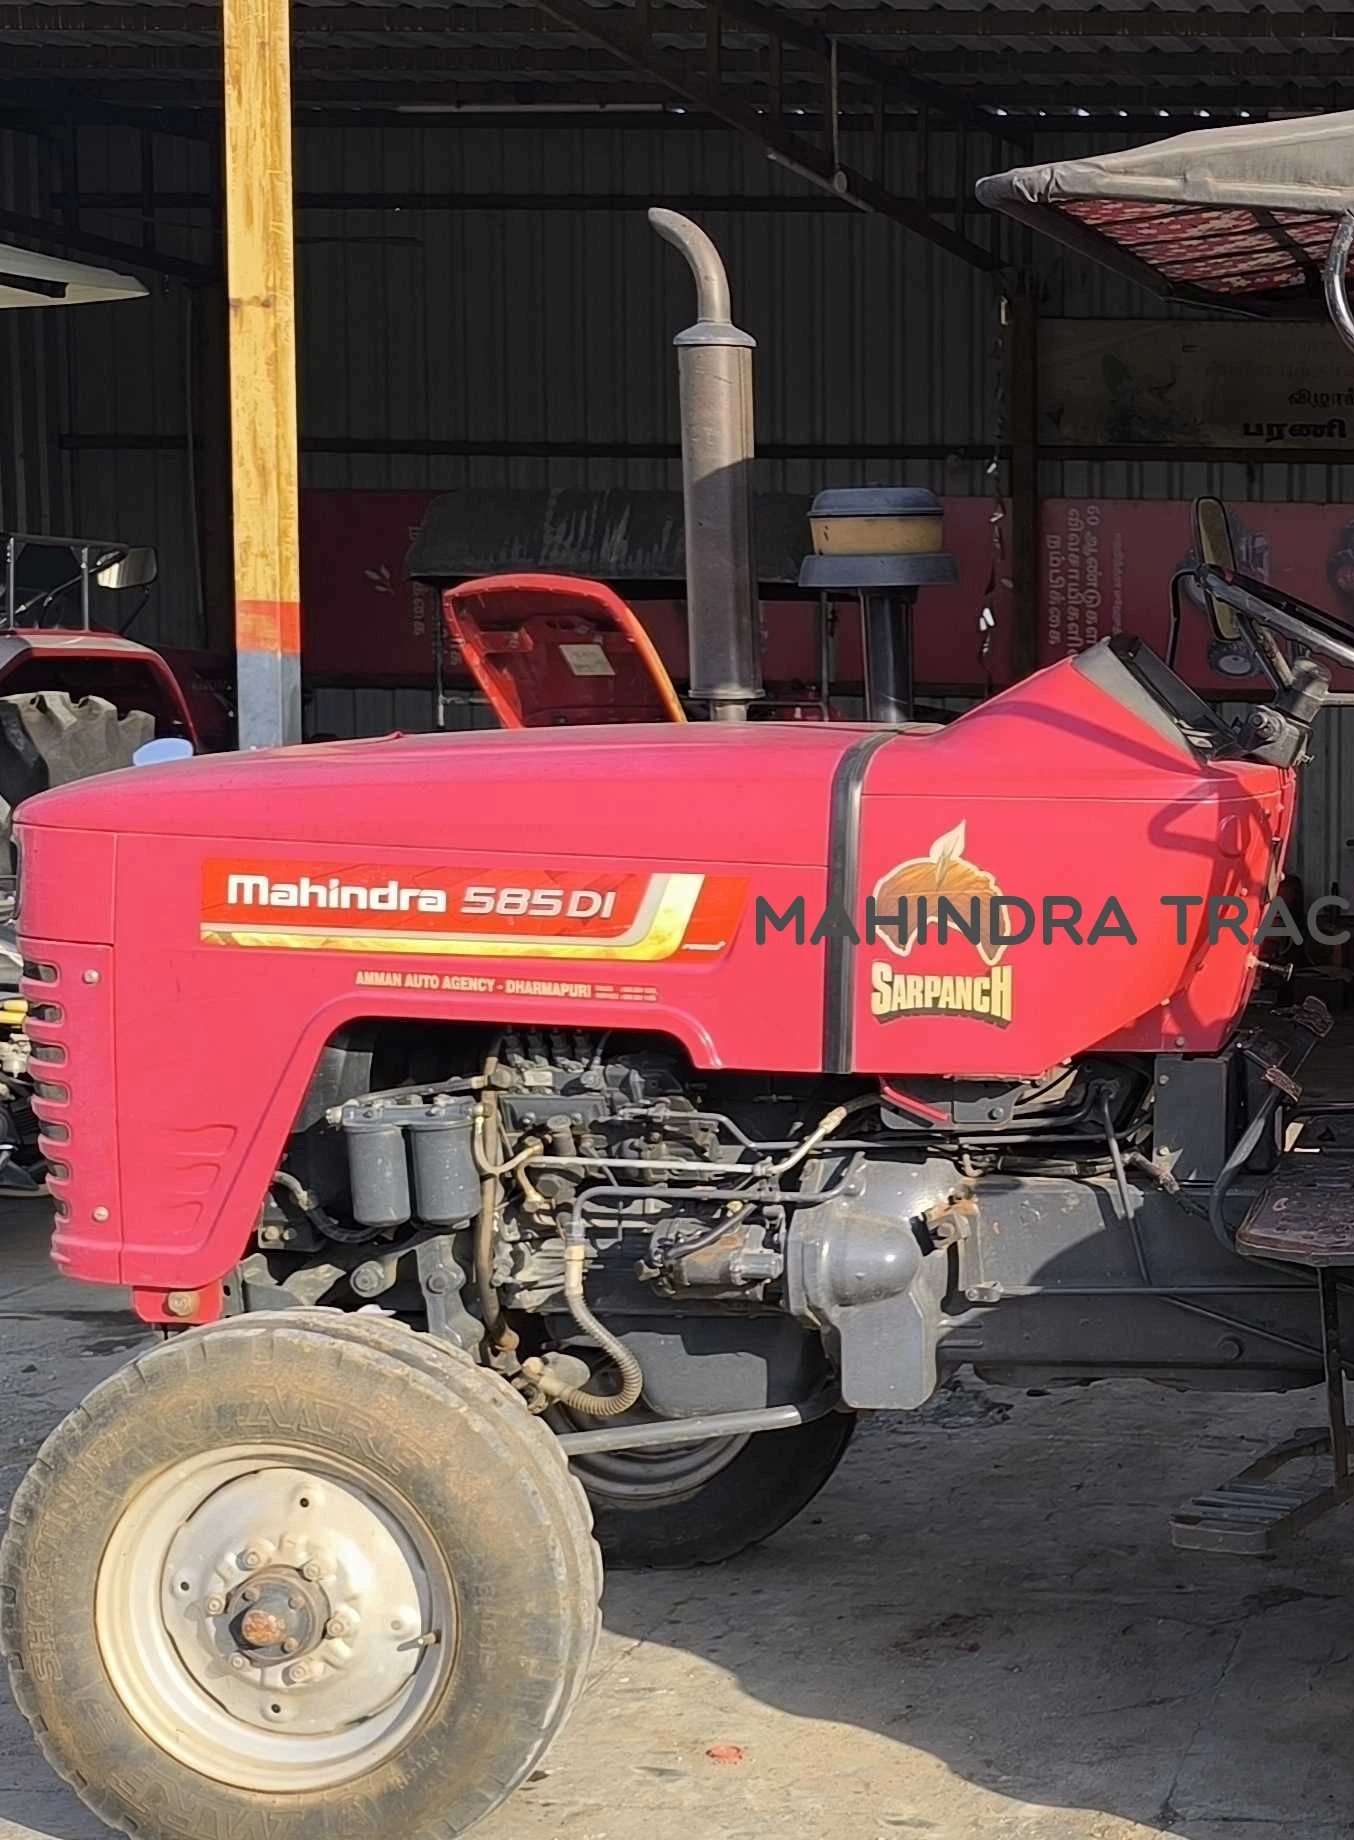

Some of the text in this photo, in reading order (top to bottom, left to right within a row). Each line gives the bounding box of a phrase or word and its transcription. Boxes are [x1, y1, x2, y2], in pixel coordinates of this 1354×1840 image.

[227, 873, 447, 913] Mahindra
[356, 970, 403, 988] AMMAN
[405, 973, 440, 989] AUTO
[442, 976, 495, 993] AGENCY
[505, 979, 592, 998] DHARMAPURI
[870, 961, 1013, 1025] SARPANCH
